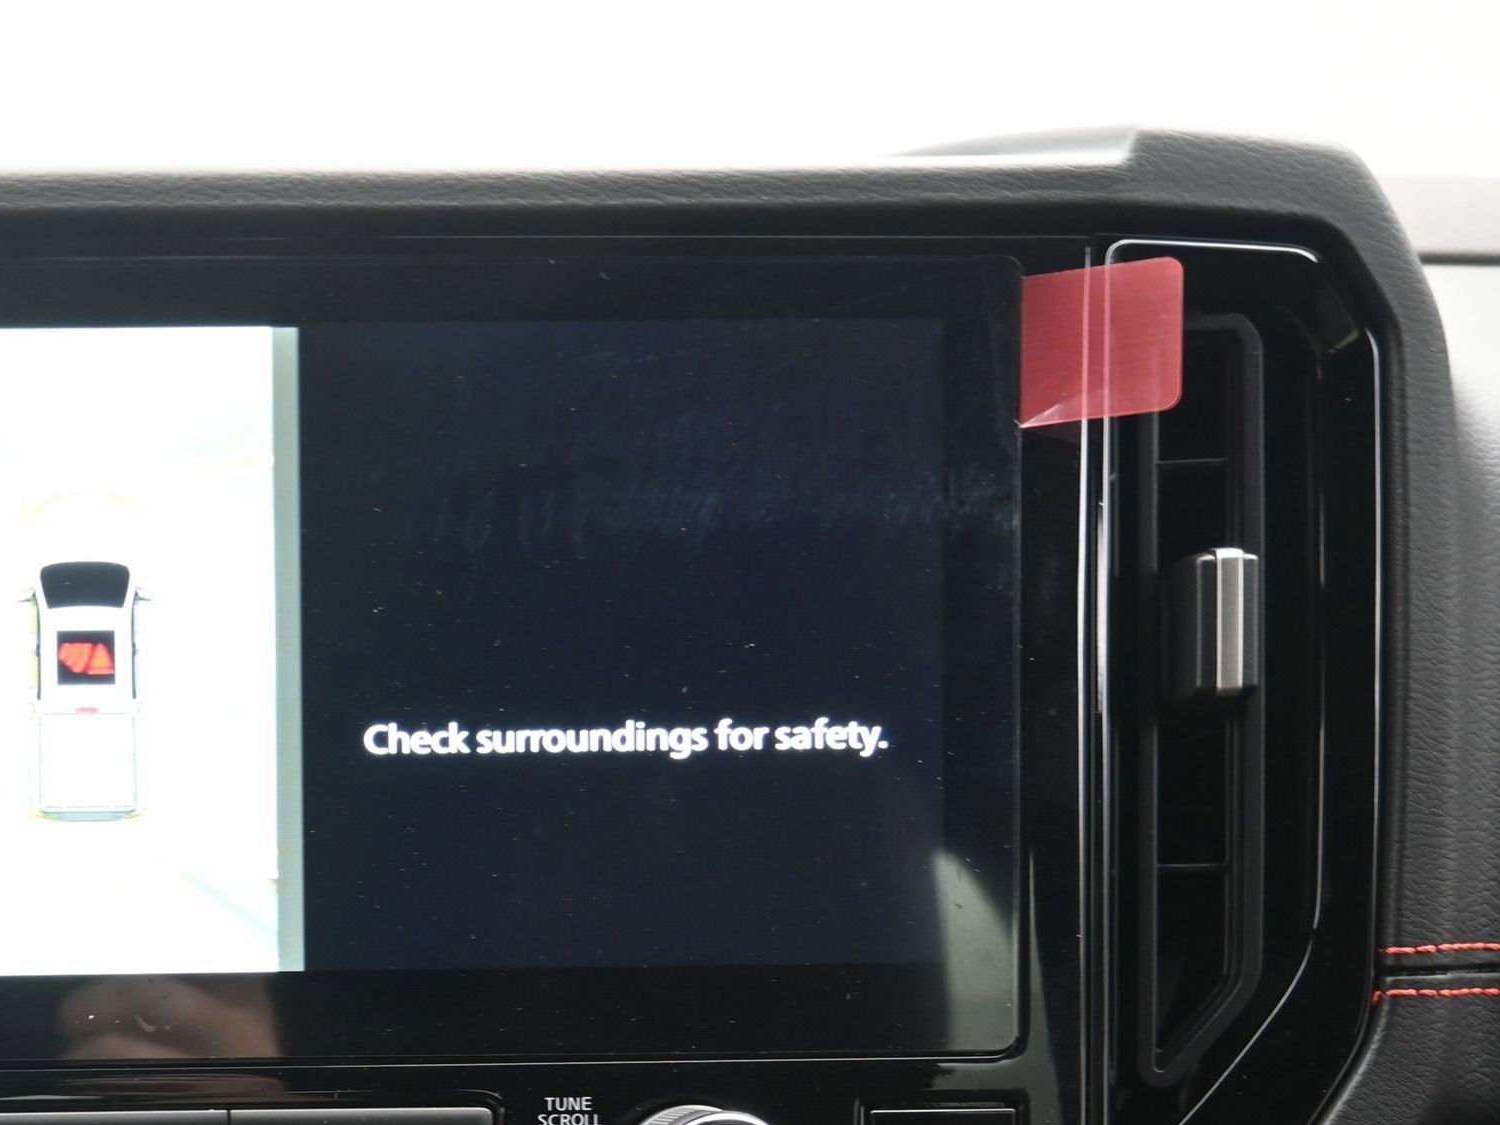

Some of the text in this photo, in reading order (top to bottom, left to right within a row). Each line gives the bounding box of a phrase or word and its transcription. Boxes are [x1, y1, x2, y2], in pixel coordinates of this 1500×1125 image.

[363, 717, 890, 761] Check surroundings for safety.
[543, 1096, 593, 1111] TUNE
